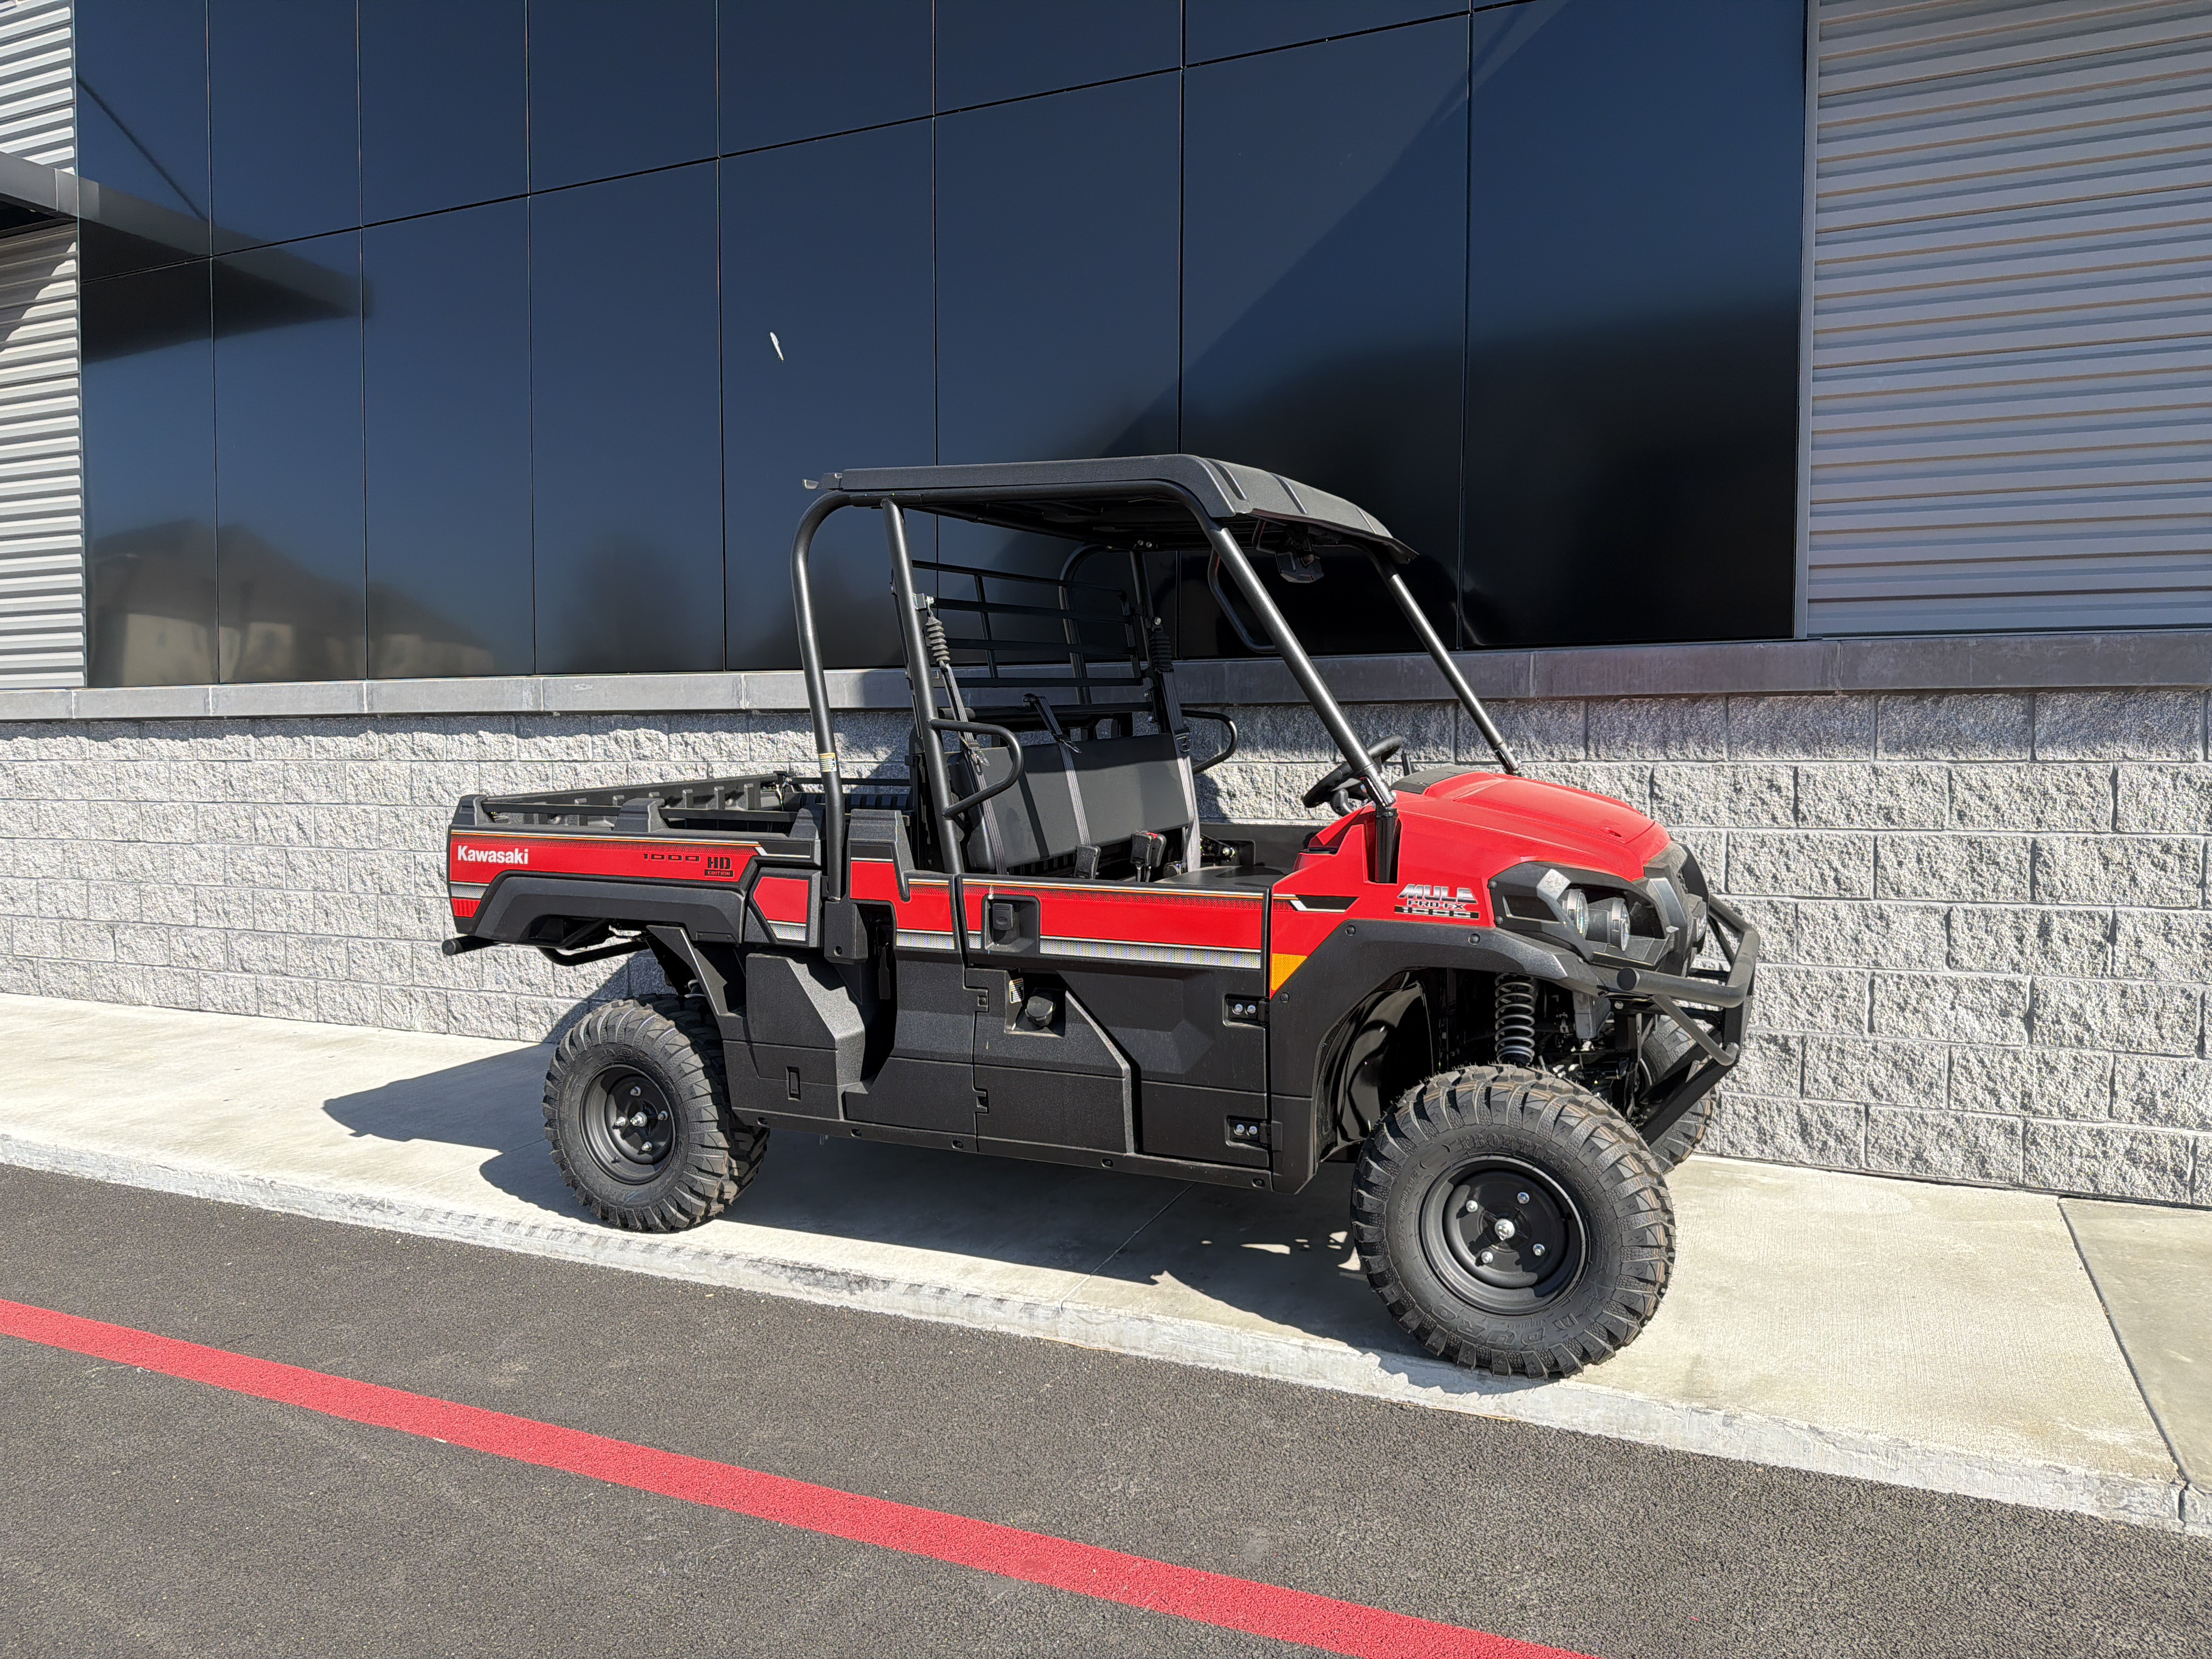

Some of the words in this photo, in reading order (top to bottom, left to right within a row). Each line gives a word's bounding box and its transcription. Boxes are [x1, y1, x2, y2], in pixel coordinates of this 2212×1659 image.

[458, 845, 528, 865] Kawasaki
[643, 853, 700, 862] 1000
[708, 856, 731, 870] HD
[1397, 883, 1478, 904] MULE
[1402, 906, 1472, 918] 1000
[1407, 899, 1466, 910] PRO-FX
[1430, 1304, 1546, 1346] DURO
